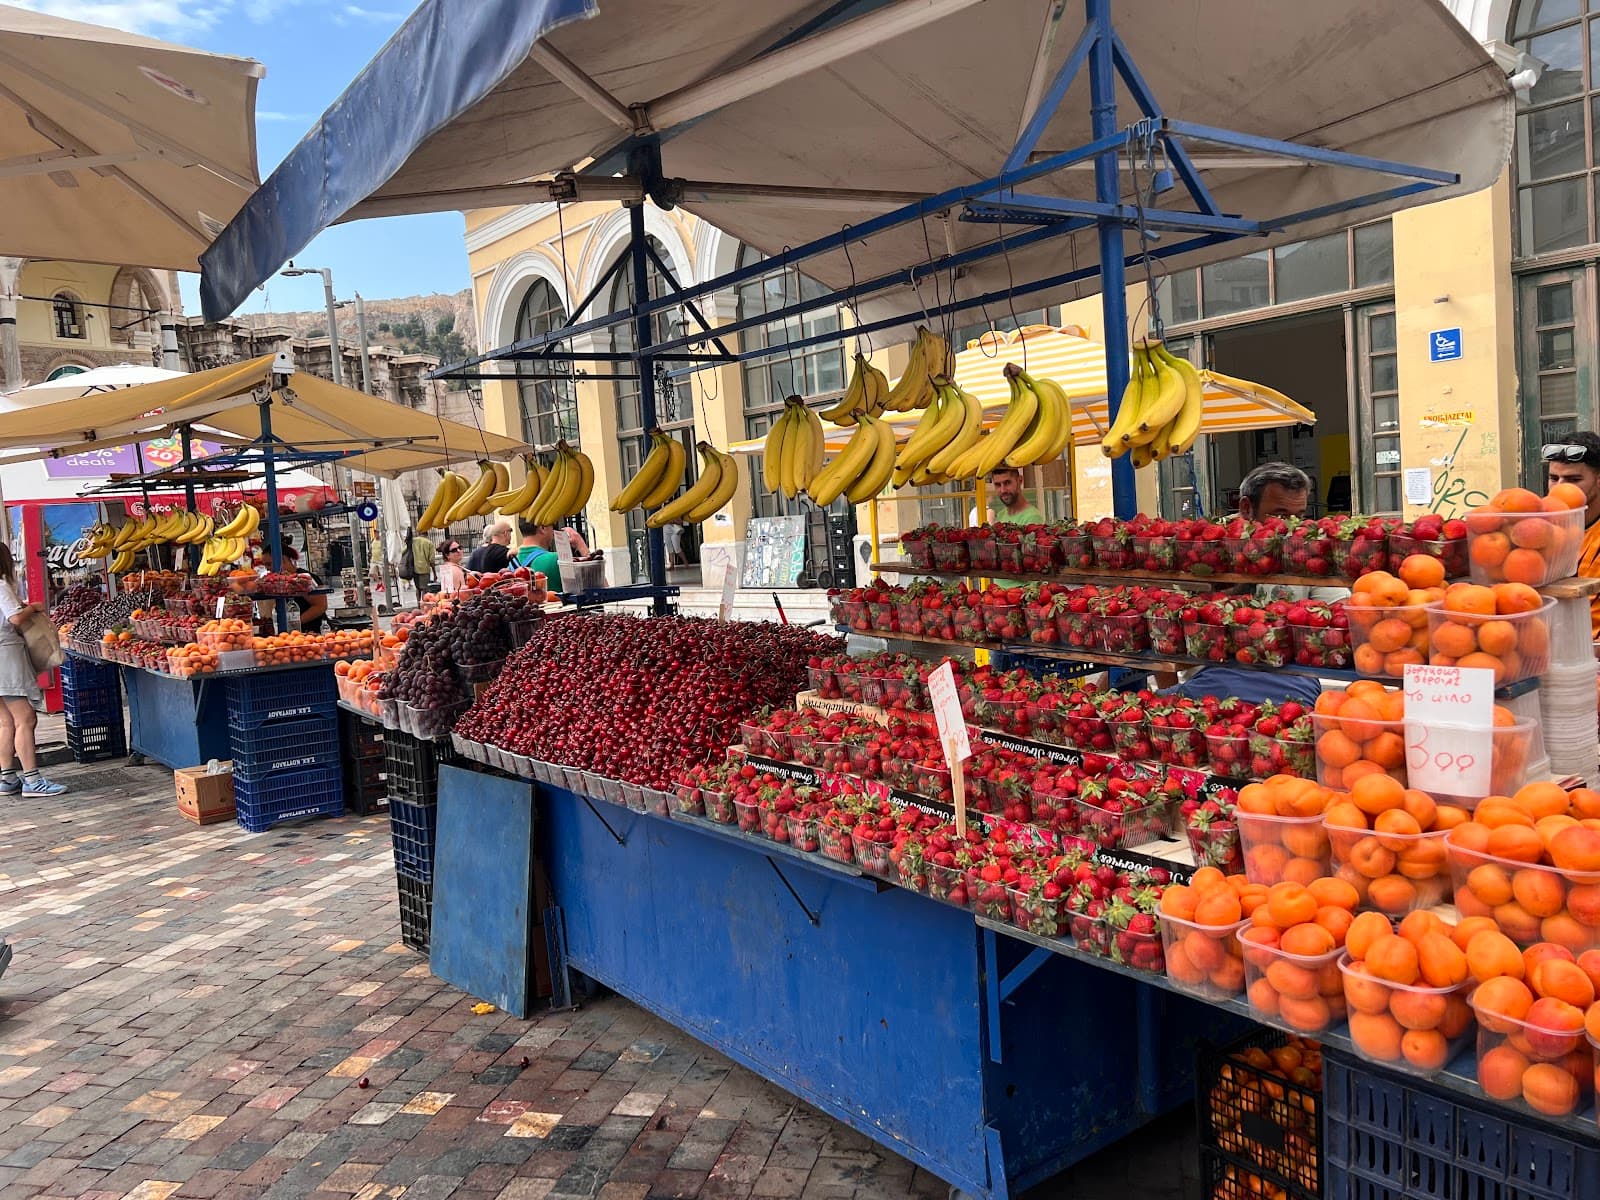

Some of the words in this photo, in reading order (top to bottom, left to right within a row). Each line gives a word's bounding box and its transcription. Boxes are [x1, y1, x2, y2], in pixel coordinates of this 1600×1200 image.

[66, 457, 116, 466] deals
[148, 503, 178, 513] efoo
[1047, 750, 1080, 765] Fresh
[791, 770, 813, 785] Fresh
[1099, 853, 1184, 884] Stberries
